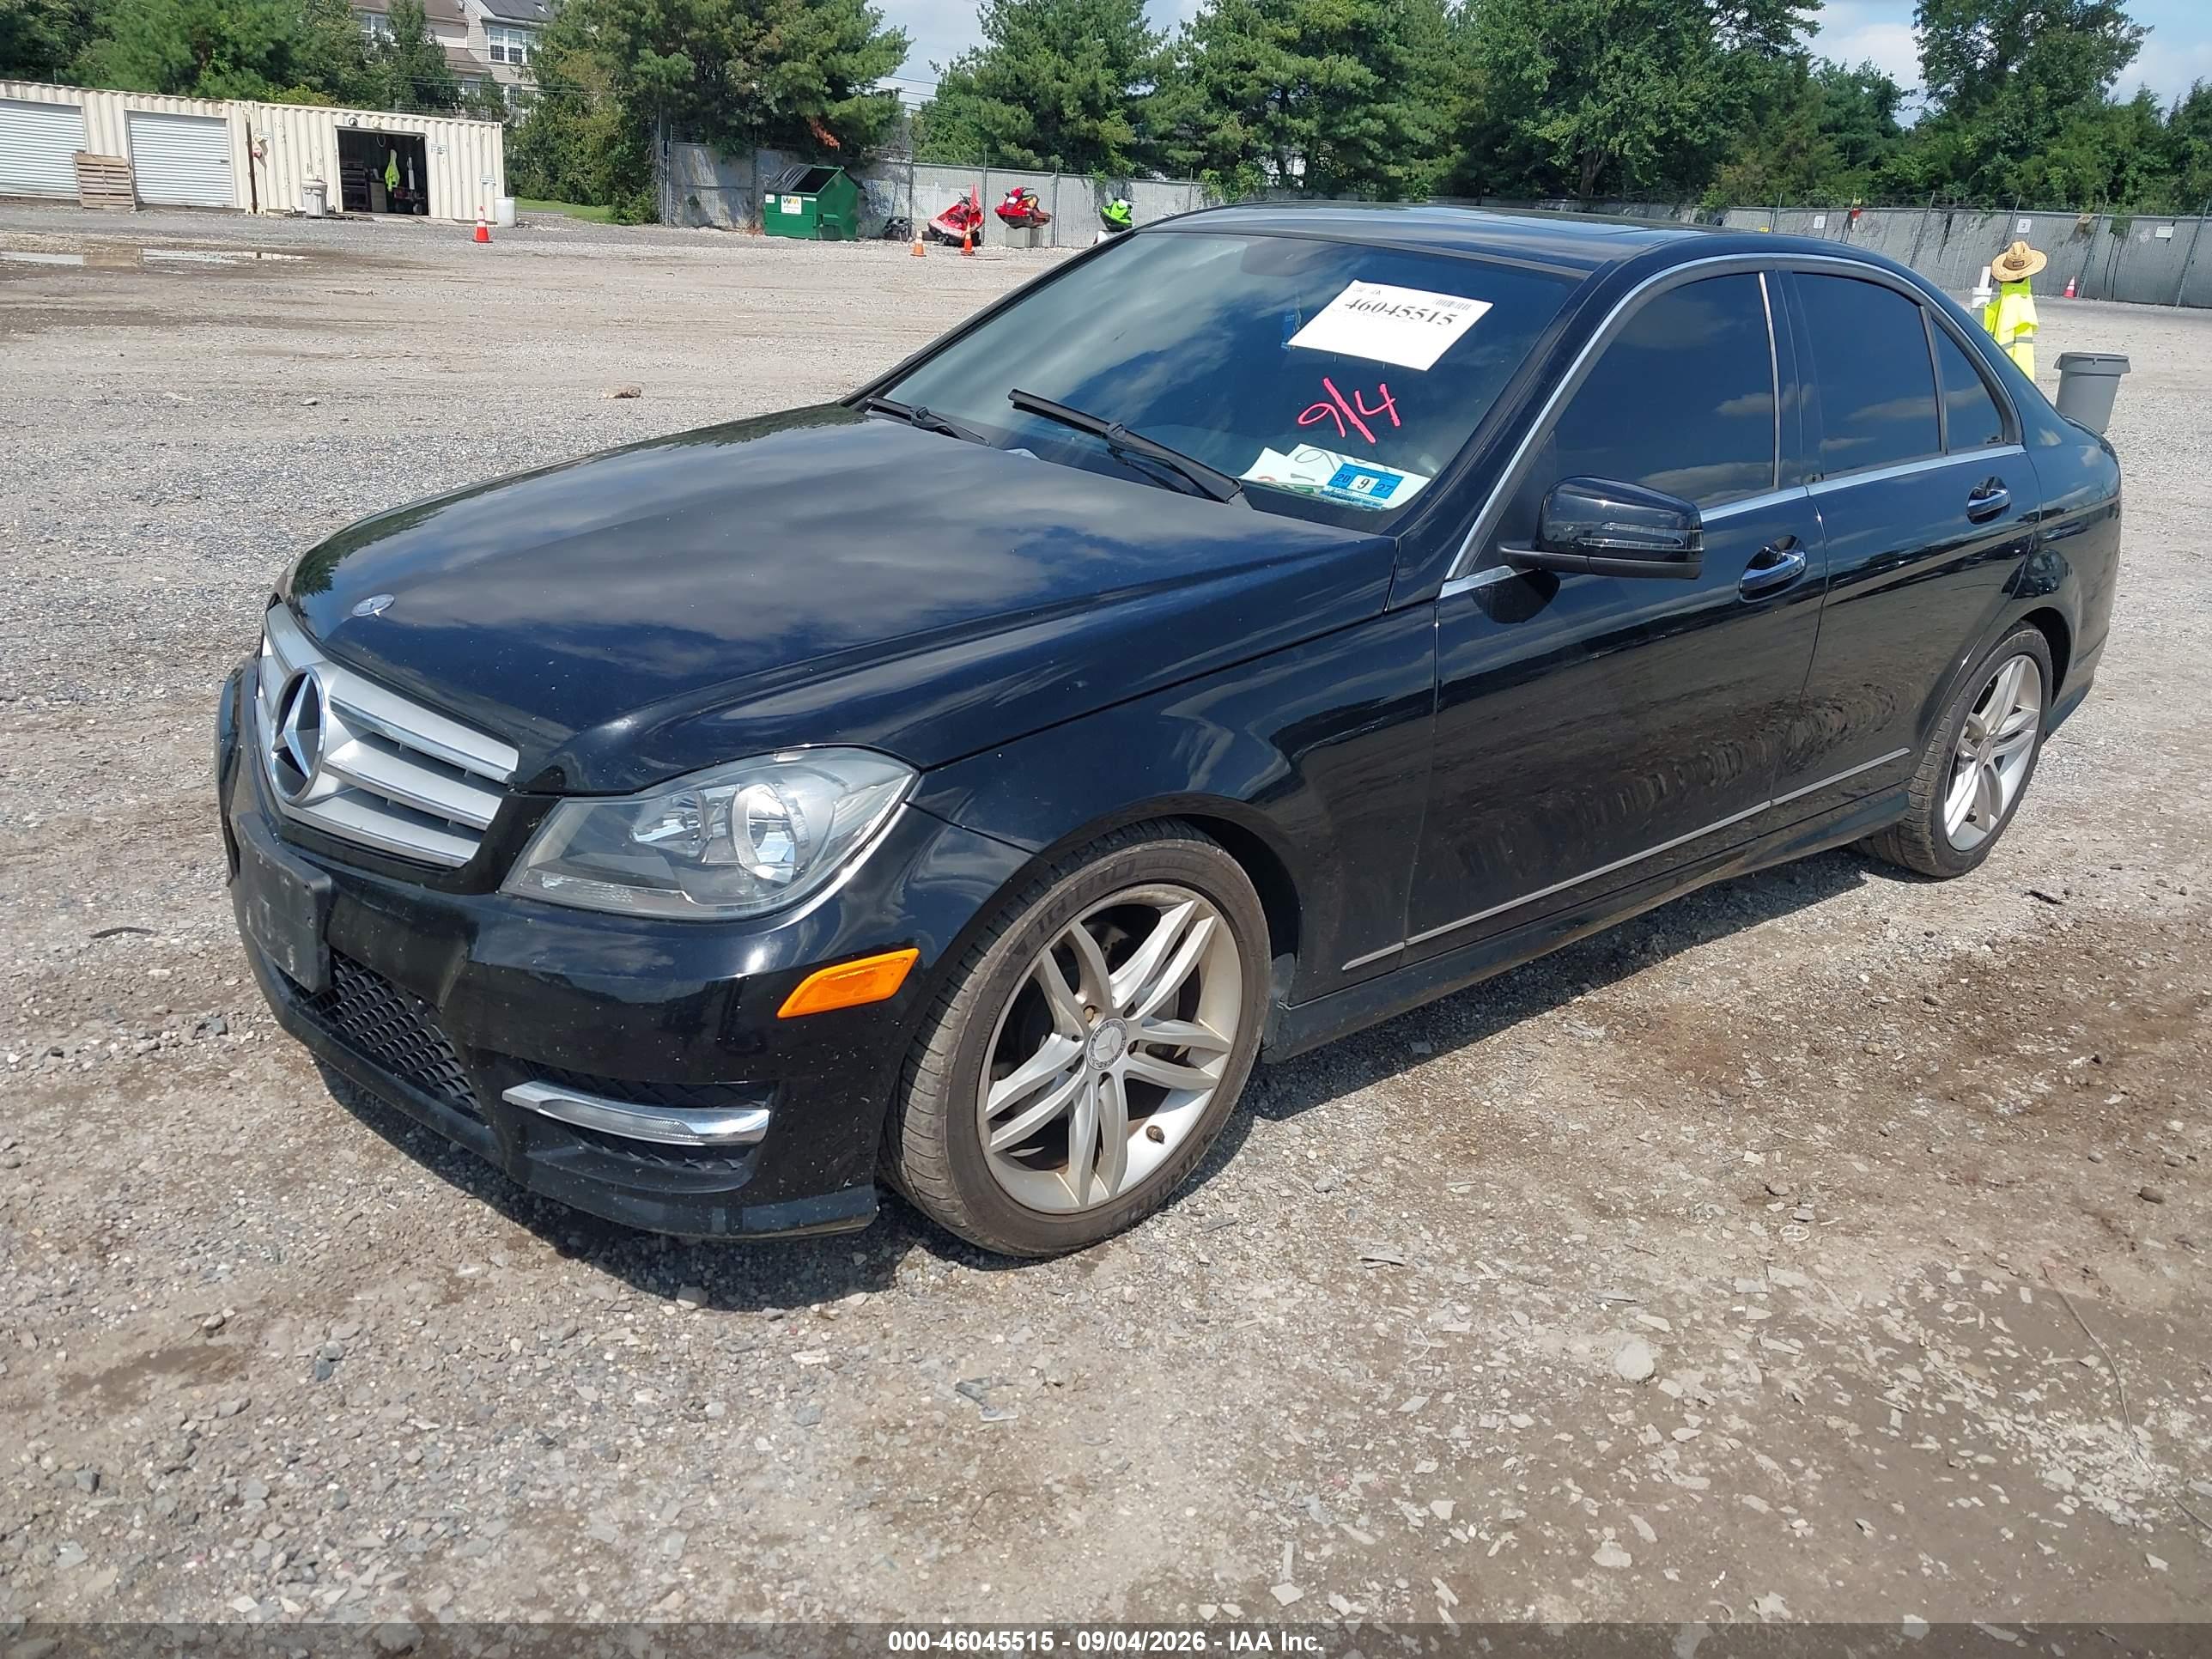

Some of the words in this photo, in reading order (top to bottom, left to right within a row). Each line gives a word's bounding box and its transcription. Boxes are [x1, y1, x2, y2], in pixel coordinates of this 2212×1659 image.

[1344, 298, 1459, 325] 46045515
[1297, 378, 1401, 444] 9/4
[1334, 473, 1352, 483] 20
[1357, 477, 1370, 489] 9
[1376, 483, 1393, 492] 27
